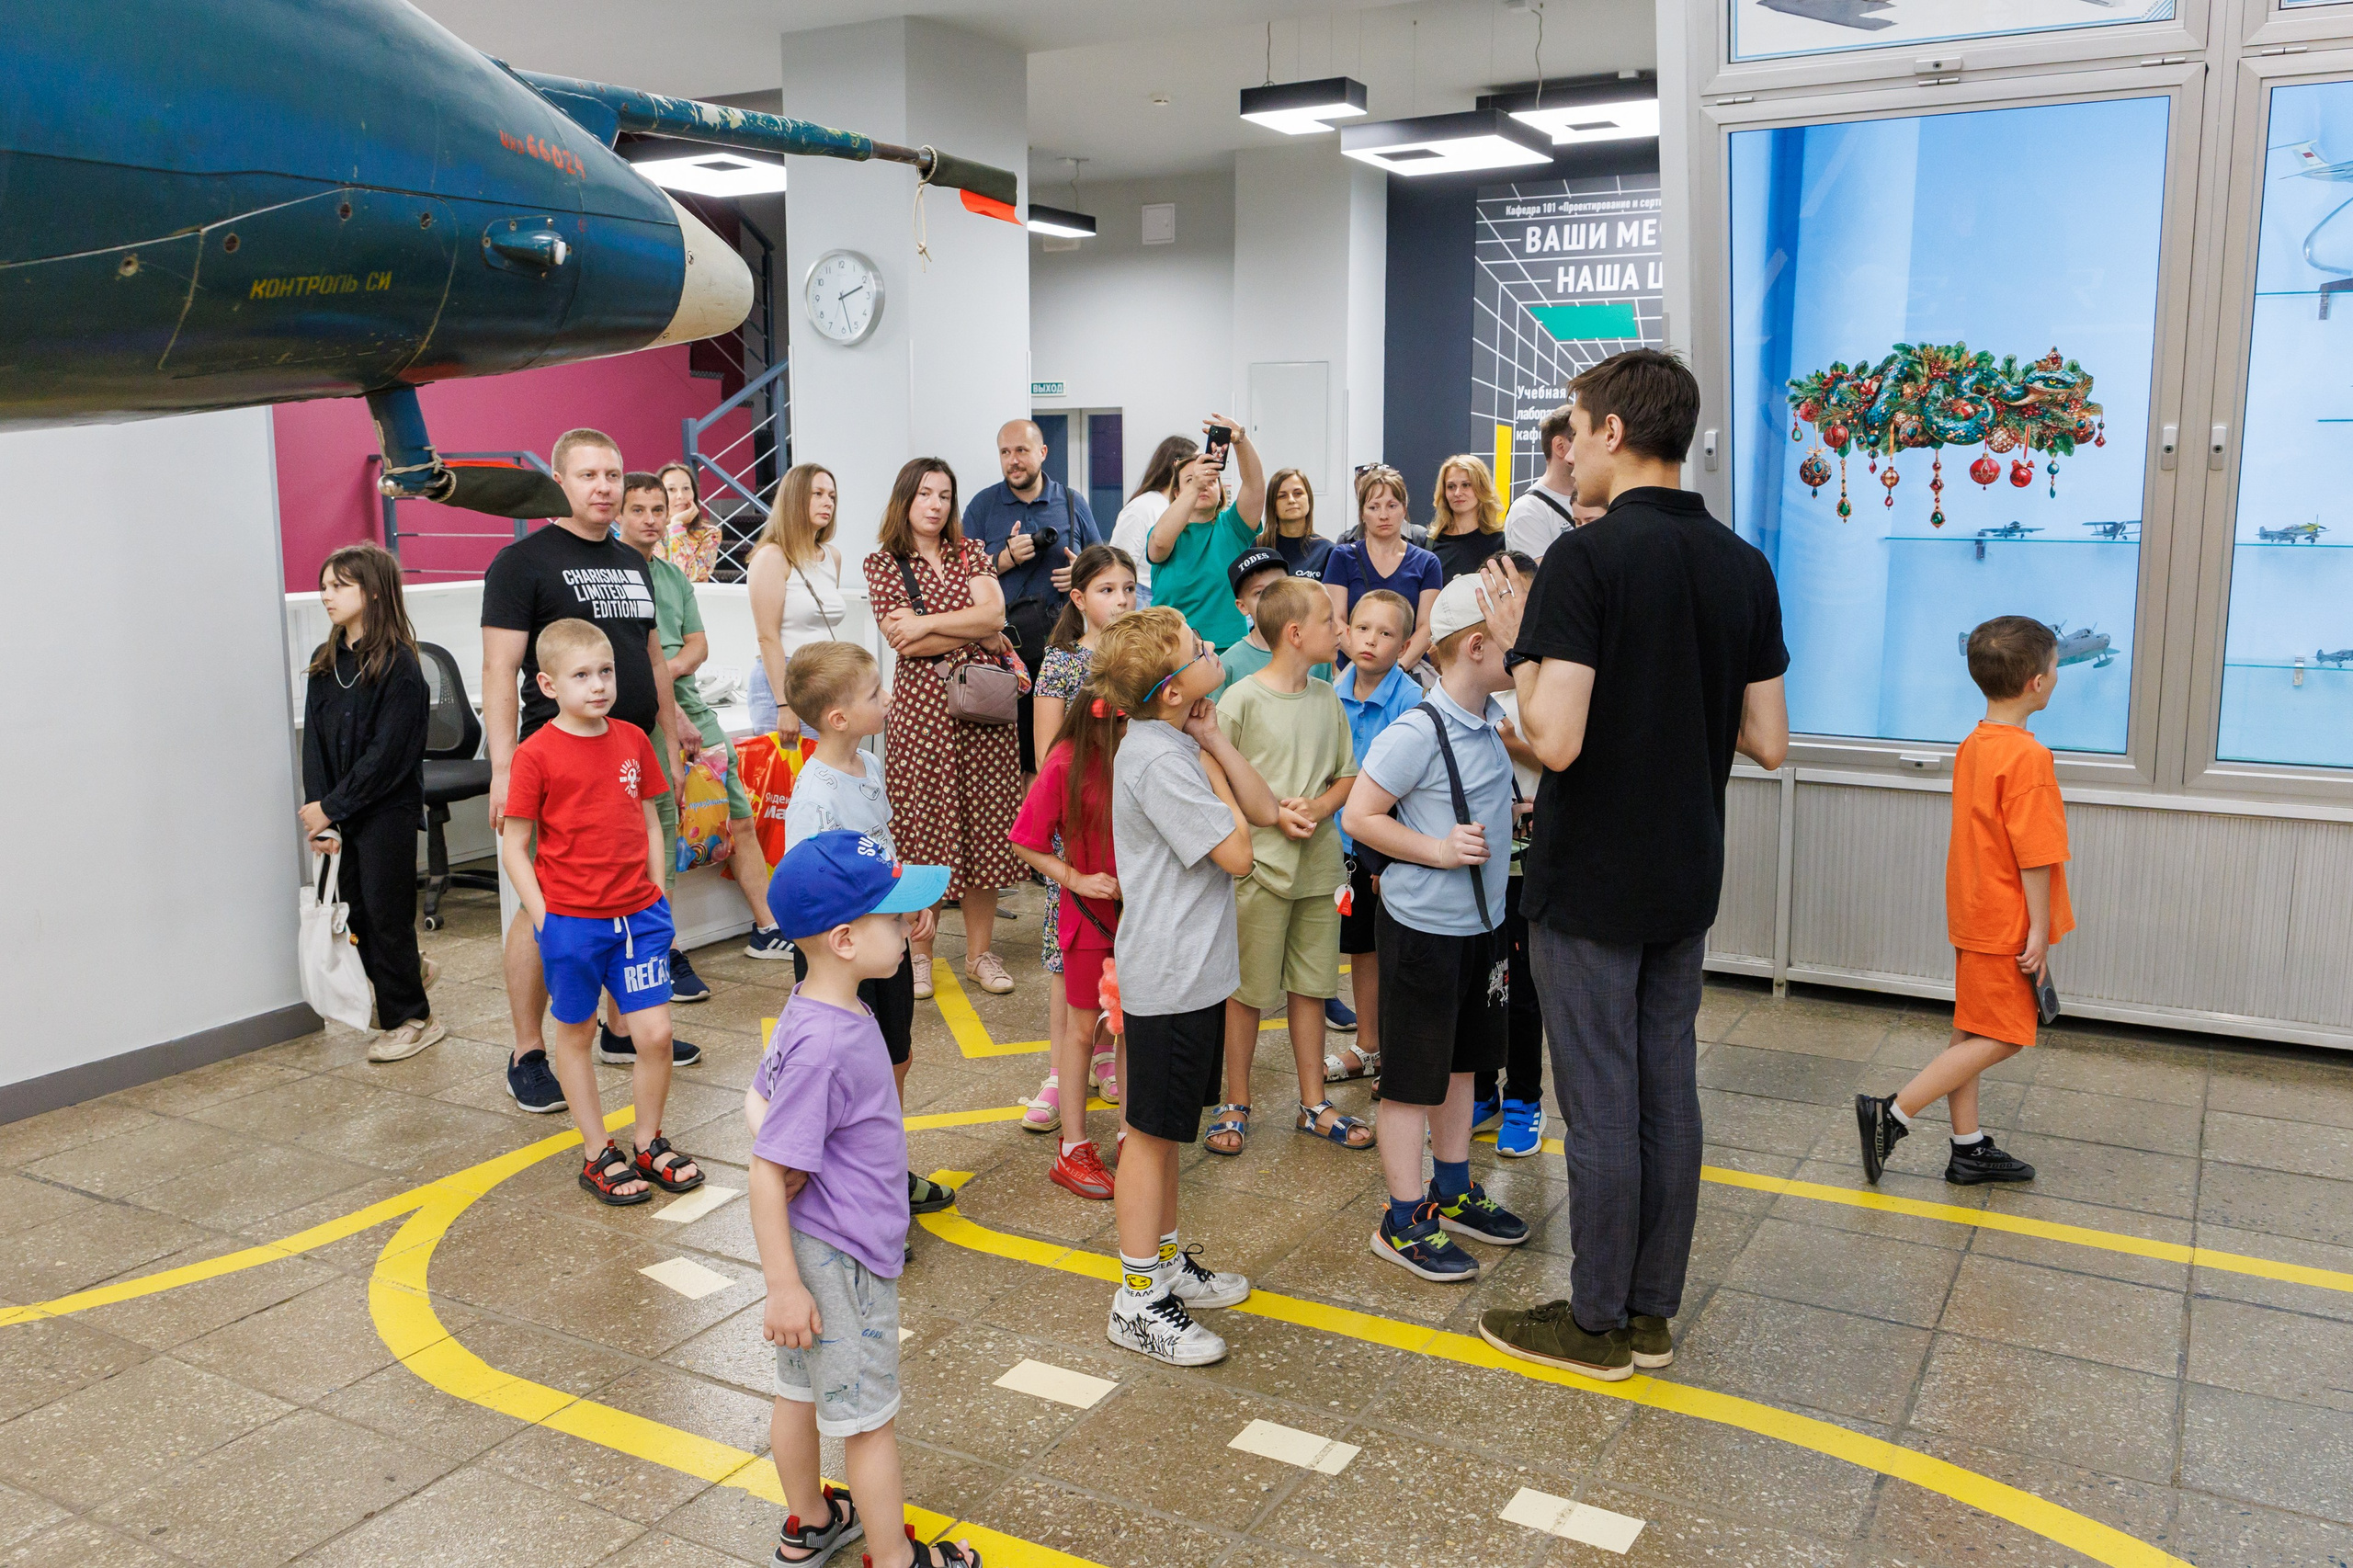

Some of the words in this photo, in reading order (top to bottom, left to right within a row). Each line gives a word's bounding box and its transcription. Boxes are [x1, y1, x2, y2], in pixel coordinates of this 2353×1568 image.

[1506, 204, 1541, 218] Кафедра
[1542, 202, 1556, 213] 101
[1631, 199, 1639, 209] и
[1526, 222, 1608, 254] ВАШИ
[1616, 218, 1662, 248] МЕ
[826, 266, 832, 275] 11
[838, 260, 846, 269] 12
[365, 270, 393, 291] СИ
[817, 278, 824, 287] 10
[861, 275, 868, 284] 2
[1556, 263, 1640, 293] НАША
[814, 294, 821, 303] 9
[866, 291, 871, 301] 3
[861, 309, 868, 317] 4
[828, 321, 834, 331] 7
[841, 326, 847, 335] 6
[853, 321, 859, 330] 5
[1032, 383, 1063, 394] ВЫХОД
[1517, 385, 1567, 400] Учебная
[1516, 405, 1555, 423] лабора
[1516, 426, 1541, 445] каф
[1238, 552, 1270, 572] TODES
[562, 568, 629, 585] CHARISMA
[574, 584, 627, 602] LIMITED
[592, 600, 639, 619] EDITION
[623, 956, 670, 994] RELA
